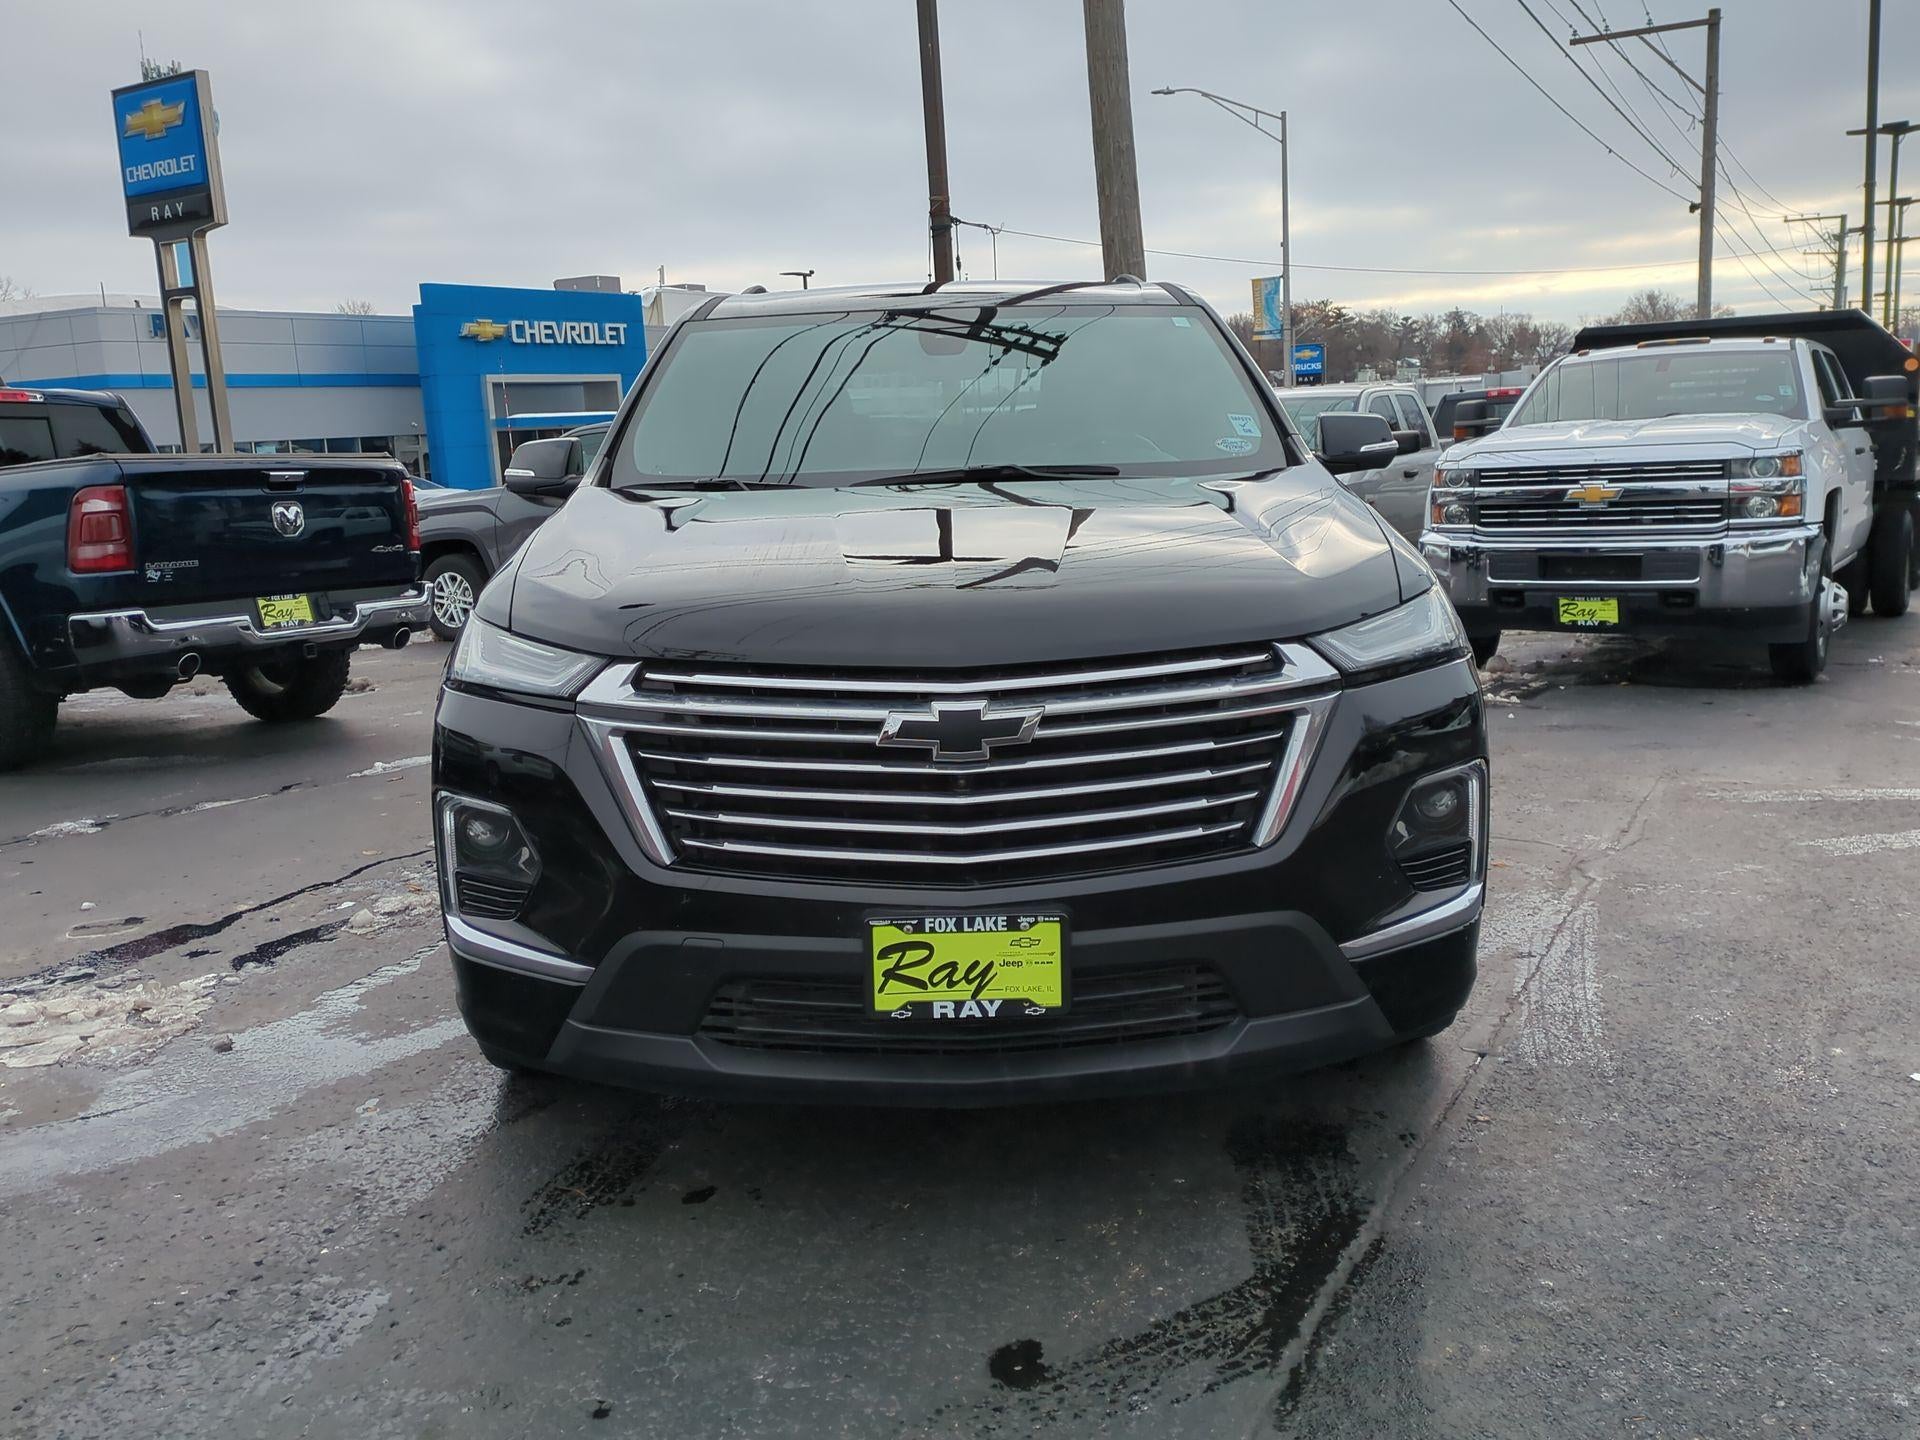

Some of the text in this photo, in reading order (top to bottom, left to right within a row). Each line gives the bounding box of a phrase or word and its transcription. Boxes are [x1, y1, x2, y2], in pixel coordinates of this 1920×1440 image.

[126, 154, 196, 183] CHEVROLET
[151, 202, 184, 221] RAY
[510, 320, 627, 345] CHEVROLET
[1290, 362, 1322, 371] TRUCKS
[261, 603, 295, 620] Ray
[1560, 602, 1598, 620] Ray
[924, 916, 1008, 933] FOX LAKE
[877, 940, 997, 1000] Ray
[999, 959, 1023, 968] Jeep
[1005, 985, 1021, 993] FOX
[1022, 985, 1045, 993] LAKE,
[933, 1000, 1003, 1019] RAY
